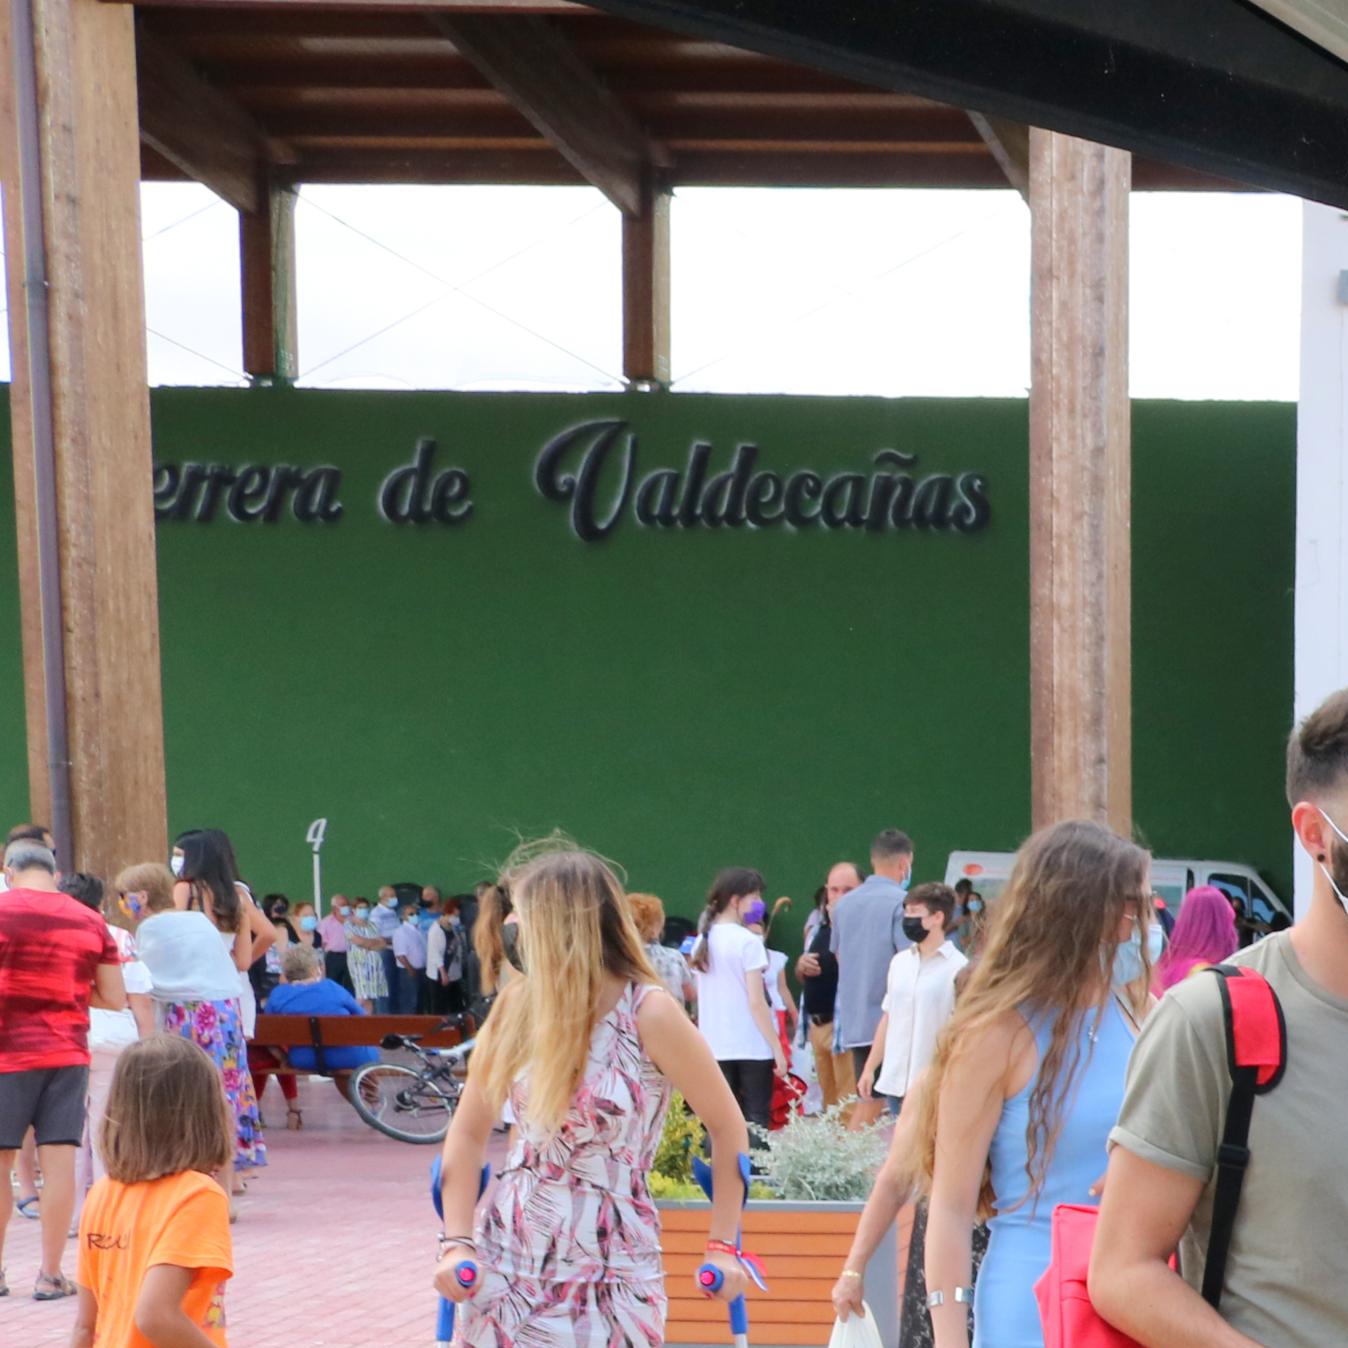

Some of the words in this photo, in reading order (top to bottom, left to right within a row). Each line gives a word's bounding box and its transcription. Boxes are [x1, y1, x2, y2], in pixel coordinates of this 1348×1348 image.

[153, 462, 343, 523] errera
[378, 437, 473, 524] de
[533, 418, 991, 542] Valdecañas
